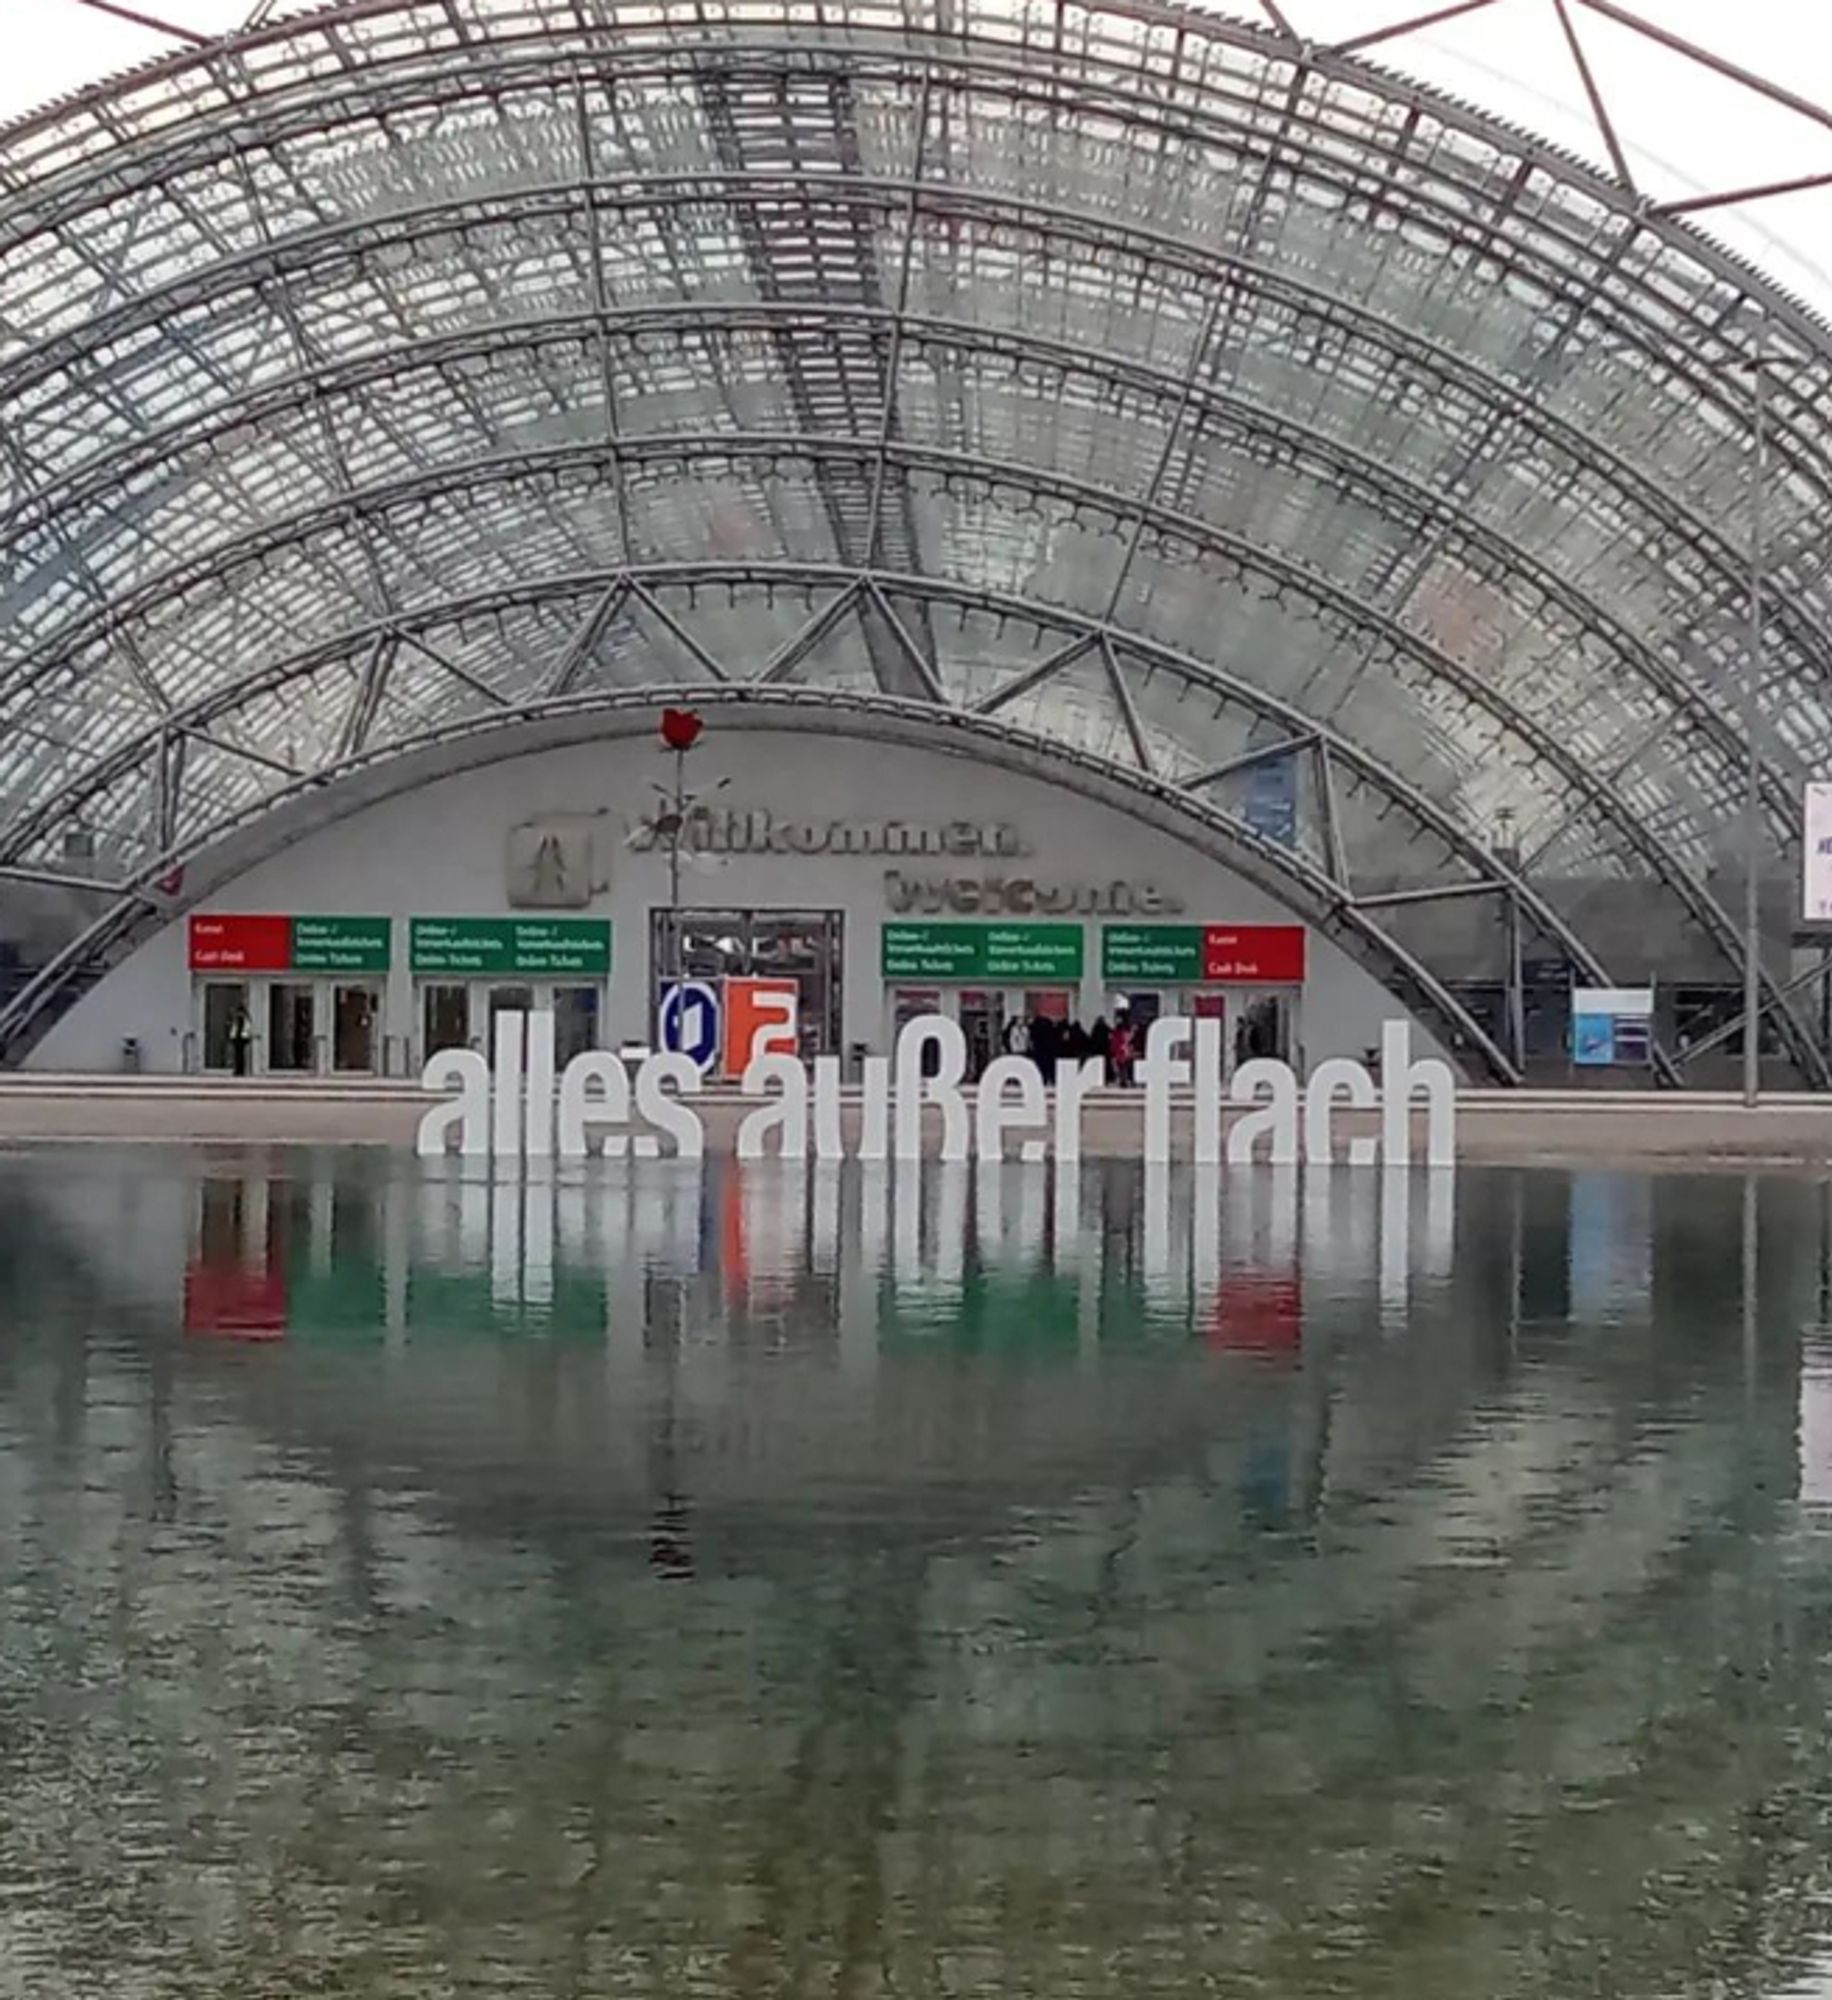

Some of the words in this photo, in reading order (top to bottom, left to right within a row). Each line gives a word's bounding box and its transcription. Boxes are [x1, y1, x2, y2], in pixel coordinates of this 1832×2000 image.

[416, 1009, 703, 1158] alles
[737, 1014, 1105, 1163] außer
[1133, 1018, 1456, 1166] flach
